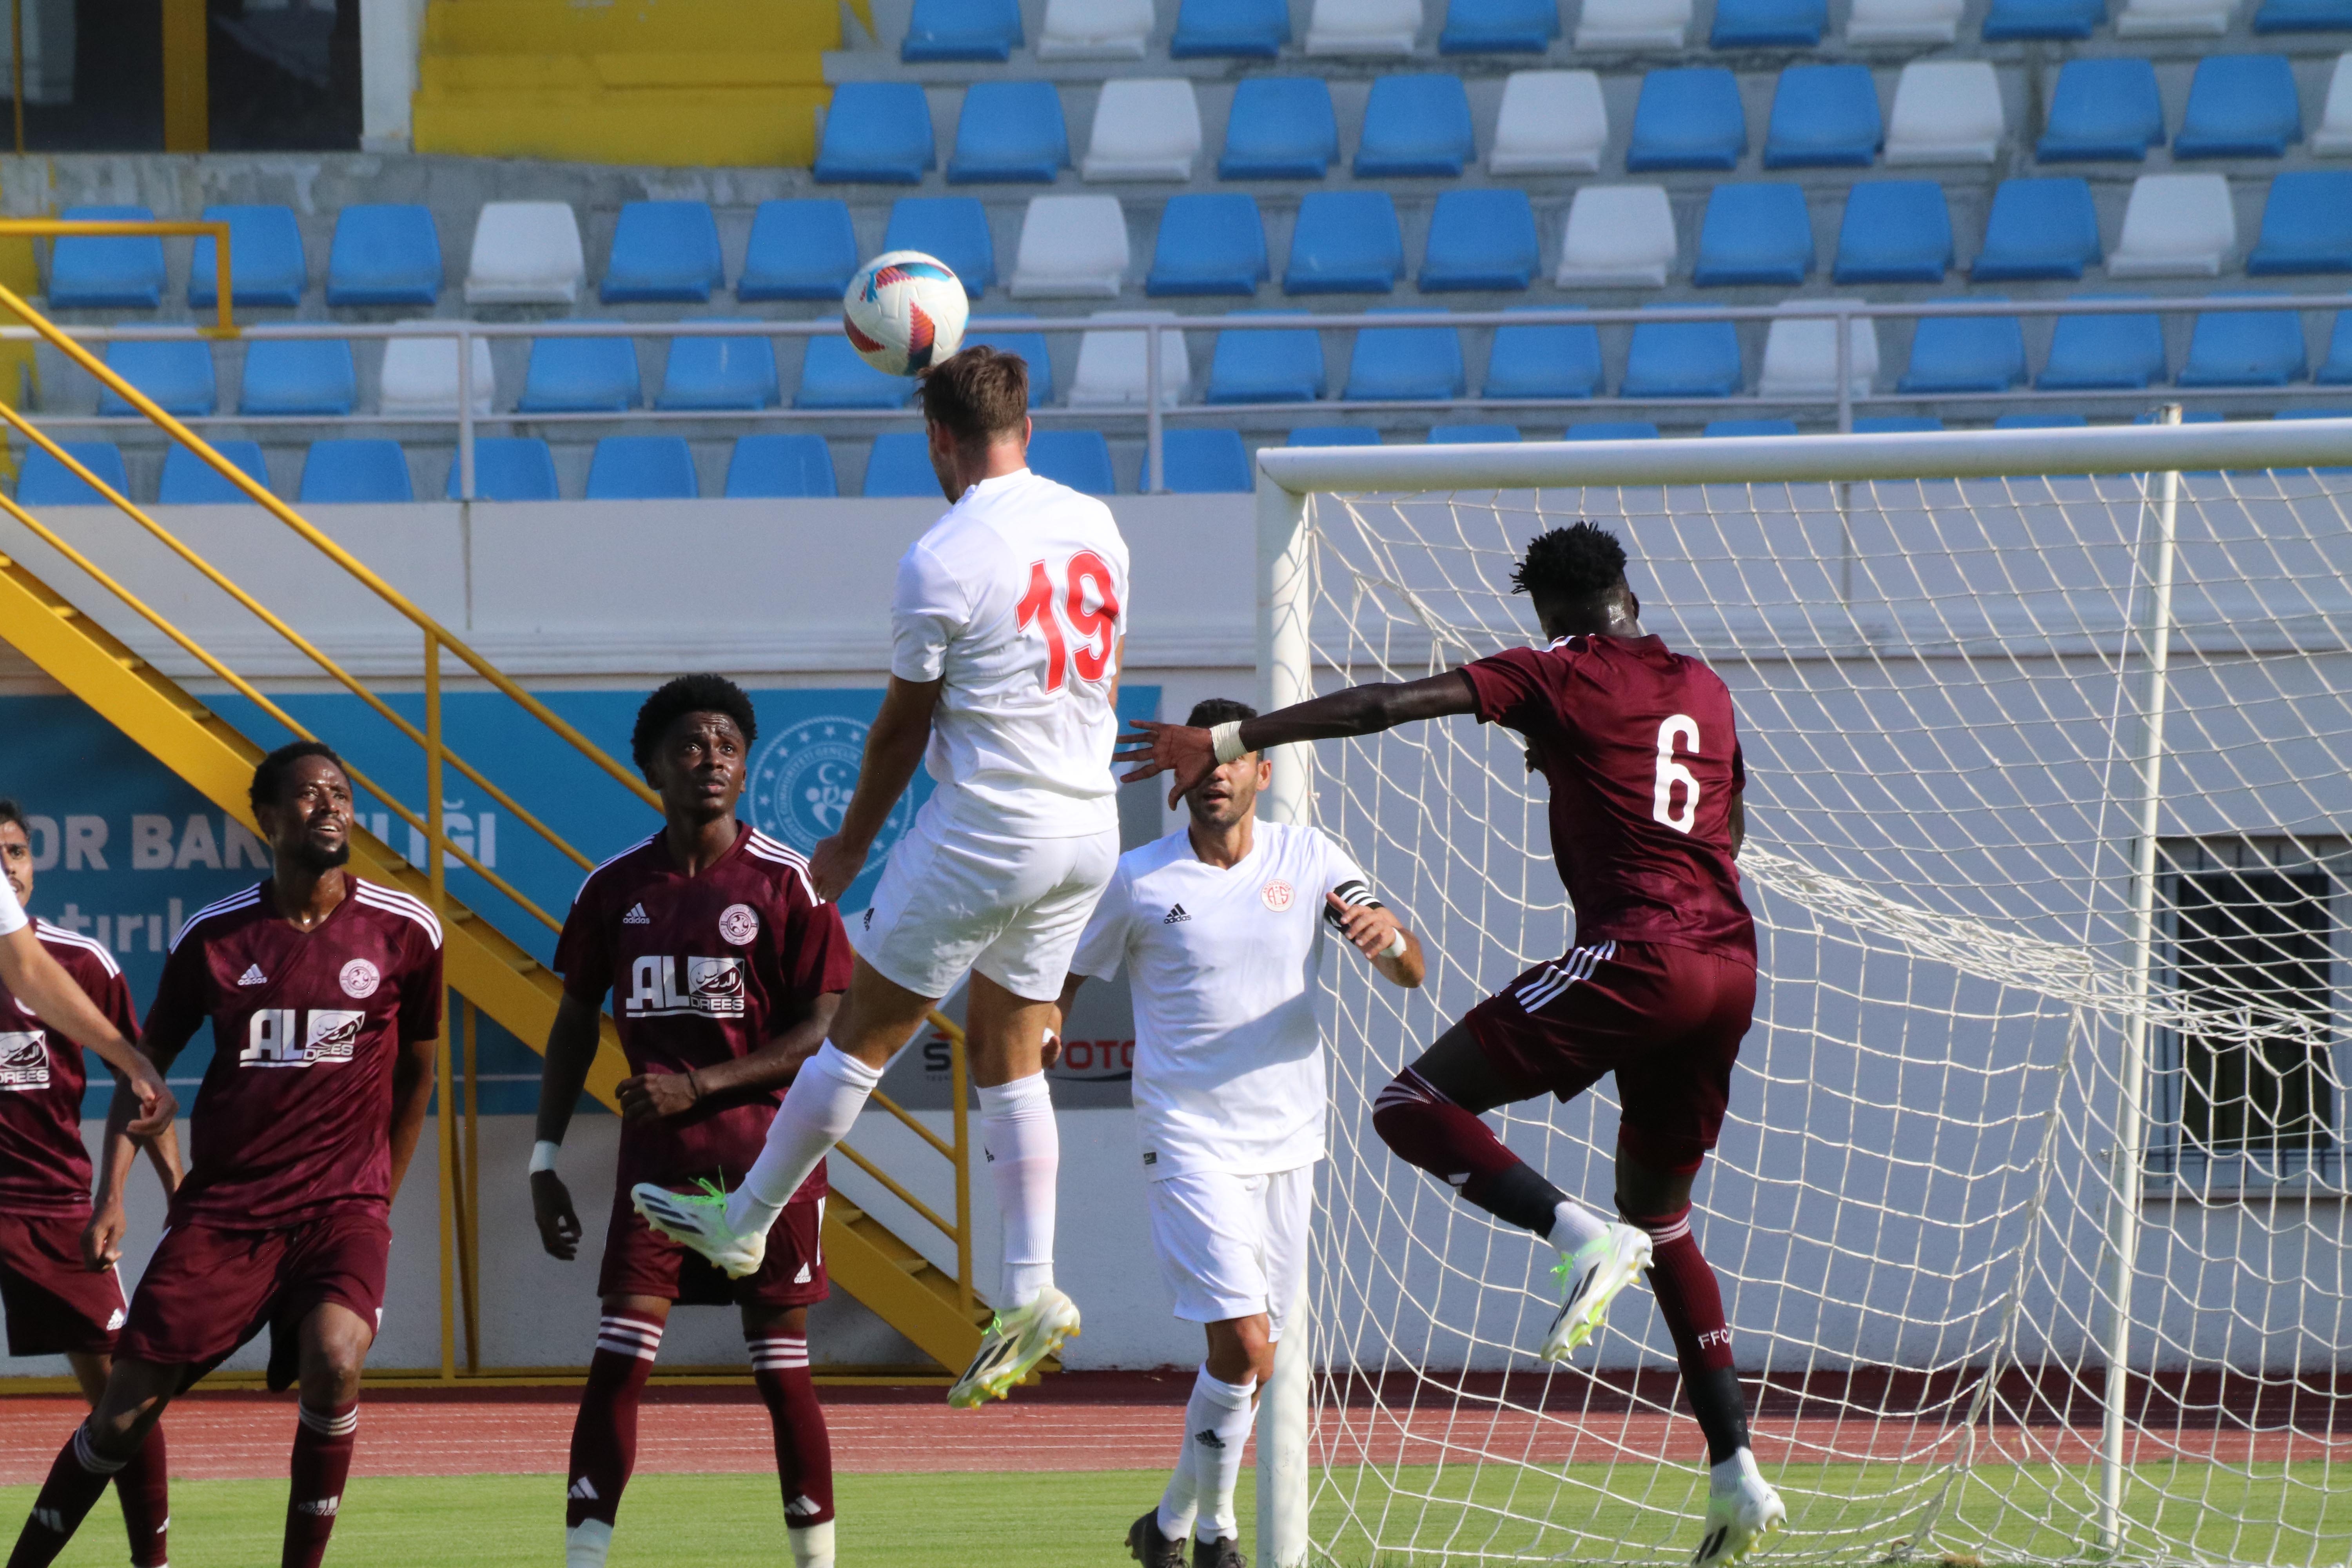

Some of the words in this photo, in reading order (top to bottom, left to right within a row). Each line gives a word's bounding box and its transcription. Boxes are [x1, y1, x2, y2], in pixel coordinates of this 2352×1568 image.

[1014, 550, 1120, 695] 19
[1653, 714, 1700, 834] 6
[24, 814, 109, 871] OR
[1164, 915, 1191, 924] adidas
[626, 955, 690, 1010] AL
[690, 996, 744, 1011] DREES
[240, 1009, 304, 1061] AL
[1698, 1328, 1729, 1349] FFC
